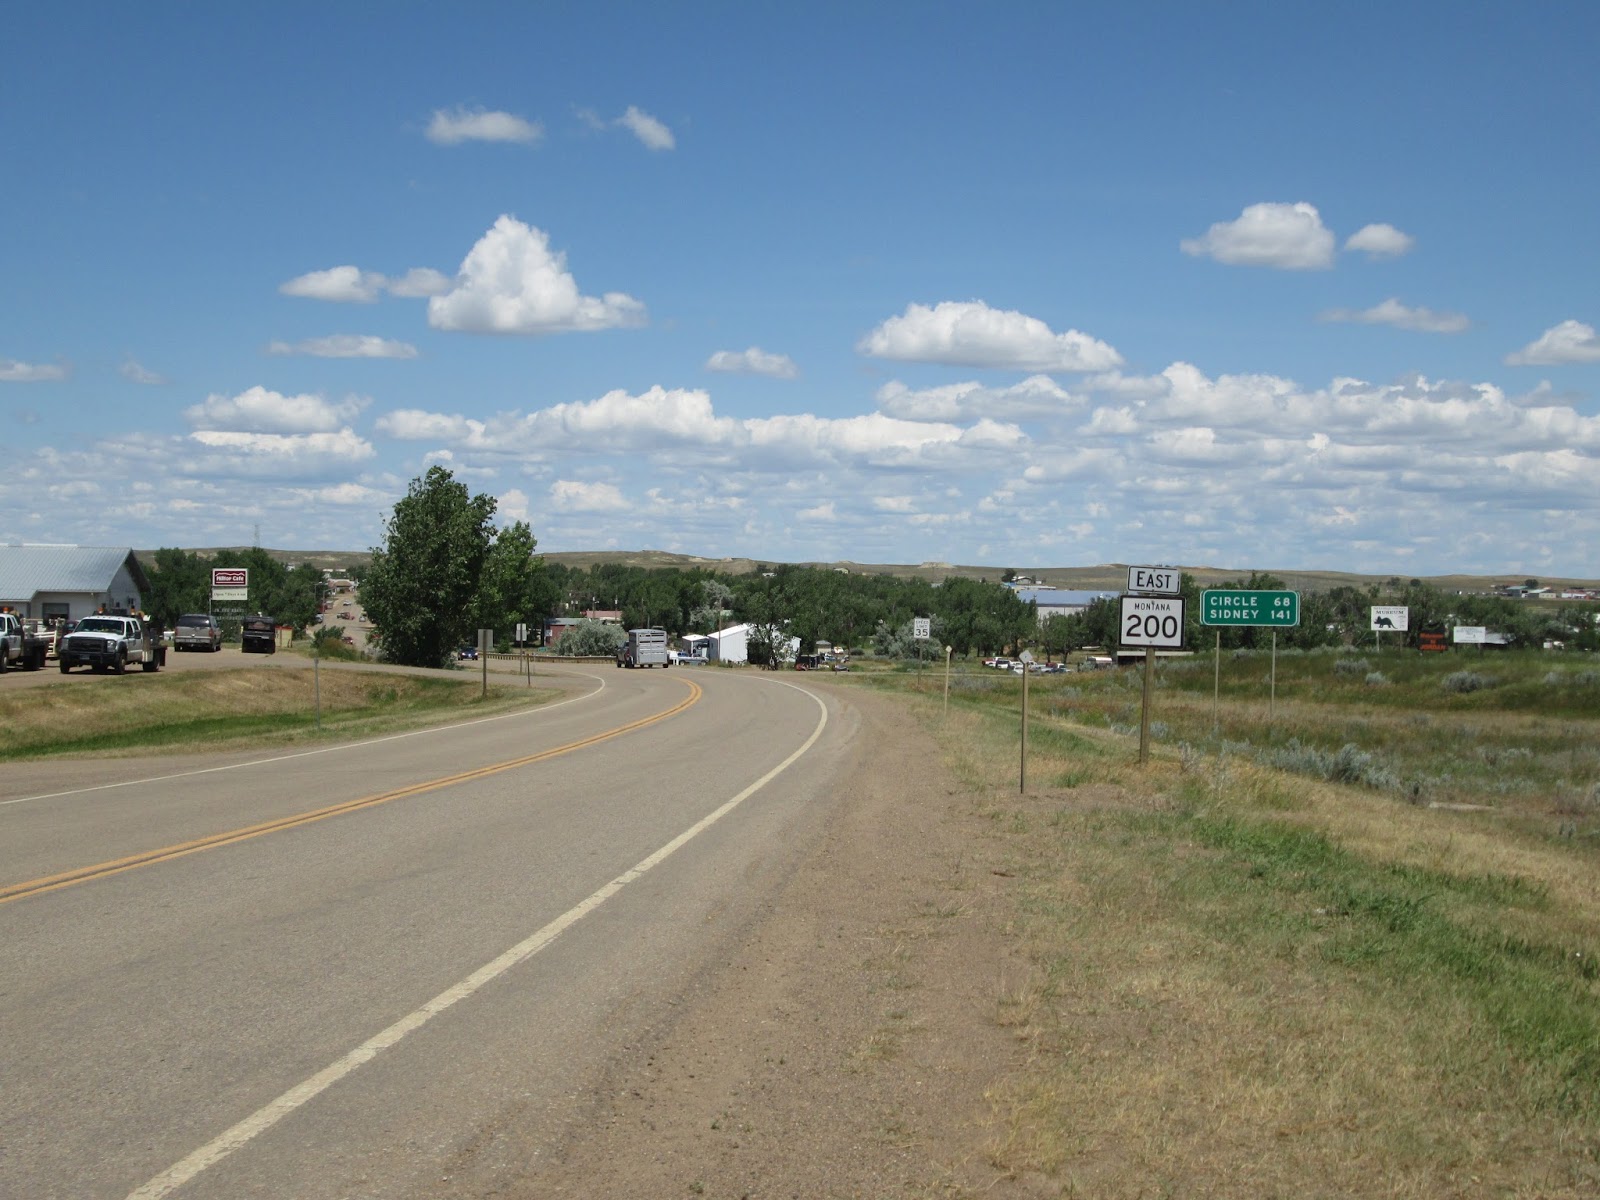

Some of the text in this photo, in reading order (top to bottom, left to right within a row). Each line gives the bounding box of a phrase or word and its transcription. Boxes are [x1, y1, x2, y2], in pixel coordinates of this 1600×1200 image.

[1136, 570, 1172, 589] EAST
[1134, 602, 1171, 611] MONTANA
[1210, 596, 1290, 607] CIRCLE 68
[1210, 609, 1290, 619] SIDNEY 141
[1126, 614, 1178, 639] 200
